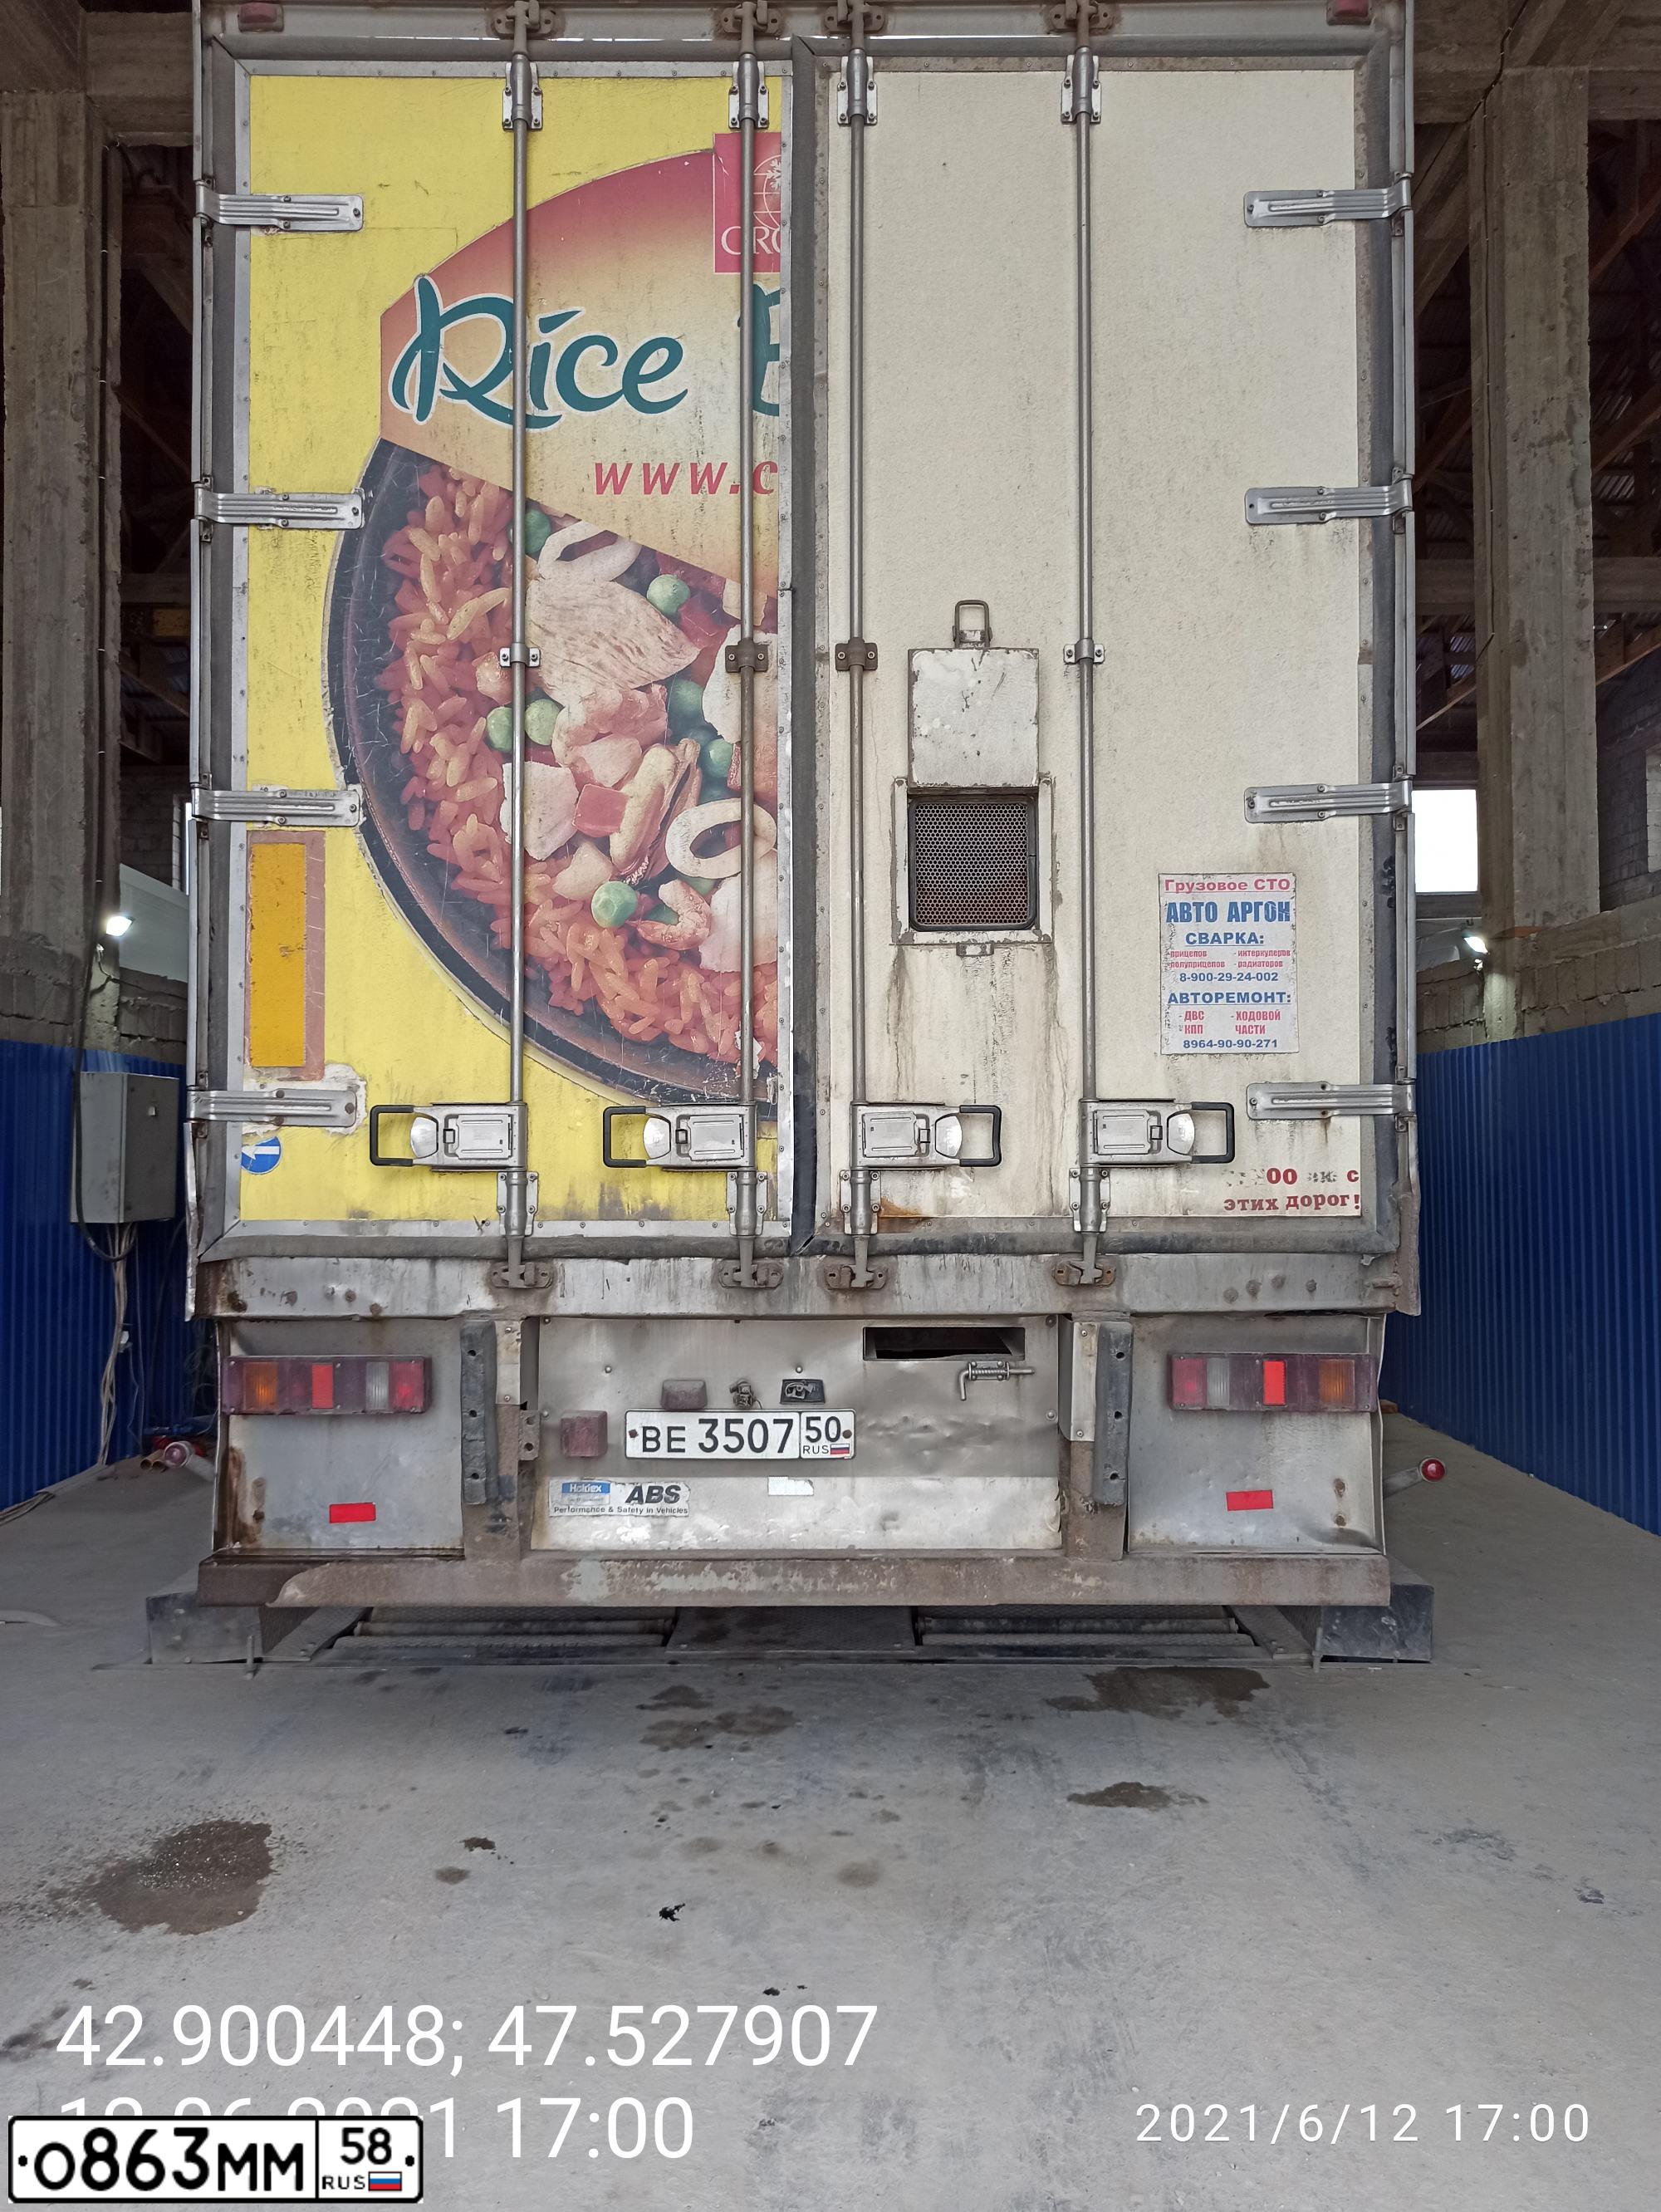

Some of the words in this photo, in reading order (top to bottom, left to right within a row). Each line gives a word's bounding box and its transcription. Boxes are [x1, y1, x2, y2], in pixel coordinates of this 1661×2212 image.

[391, 277, 688, 429] Rice
[1165, 880, 1248, 894] Грузовое
[1254, 879, 1290, 890] СТО
[1166, 901, 1218, 923] АВТО
[1227, 901, 1291, 922] АРГОН
[1185, 932, 1265, 944] СВАРКА:
[1179, 973, 1278, 982] 8-900-29-24-002
[1168, 992, 1291, 1003] АВТОРЕМОНТ:
[1236, 1009, 1281, 1021] ХОДОВОЙ
[1236, 1024, 1266, 1035] ЧАСТИ
[1183, 1039, 1278, 1048] 8964-90-90-271
[1223, 1199, 1279, 1210] этих
[698, 1418, 794, 1454] 3507
[806, 1415, 841, 1443] 50
[802, 1444, 829, 1454] RUS
[625, 1484, 682, 1504] ABS
